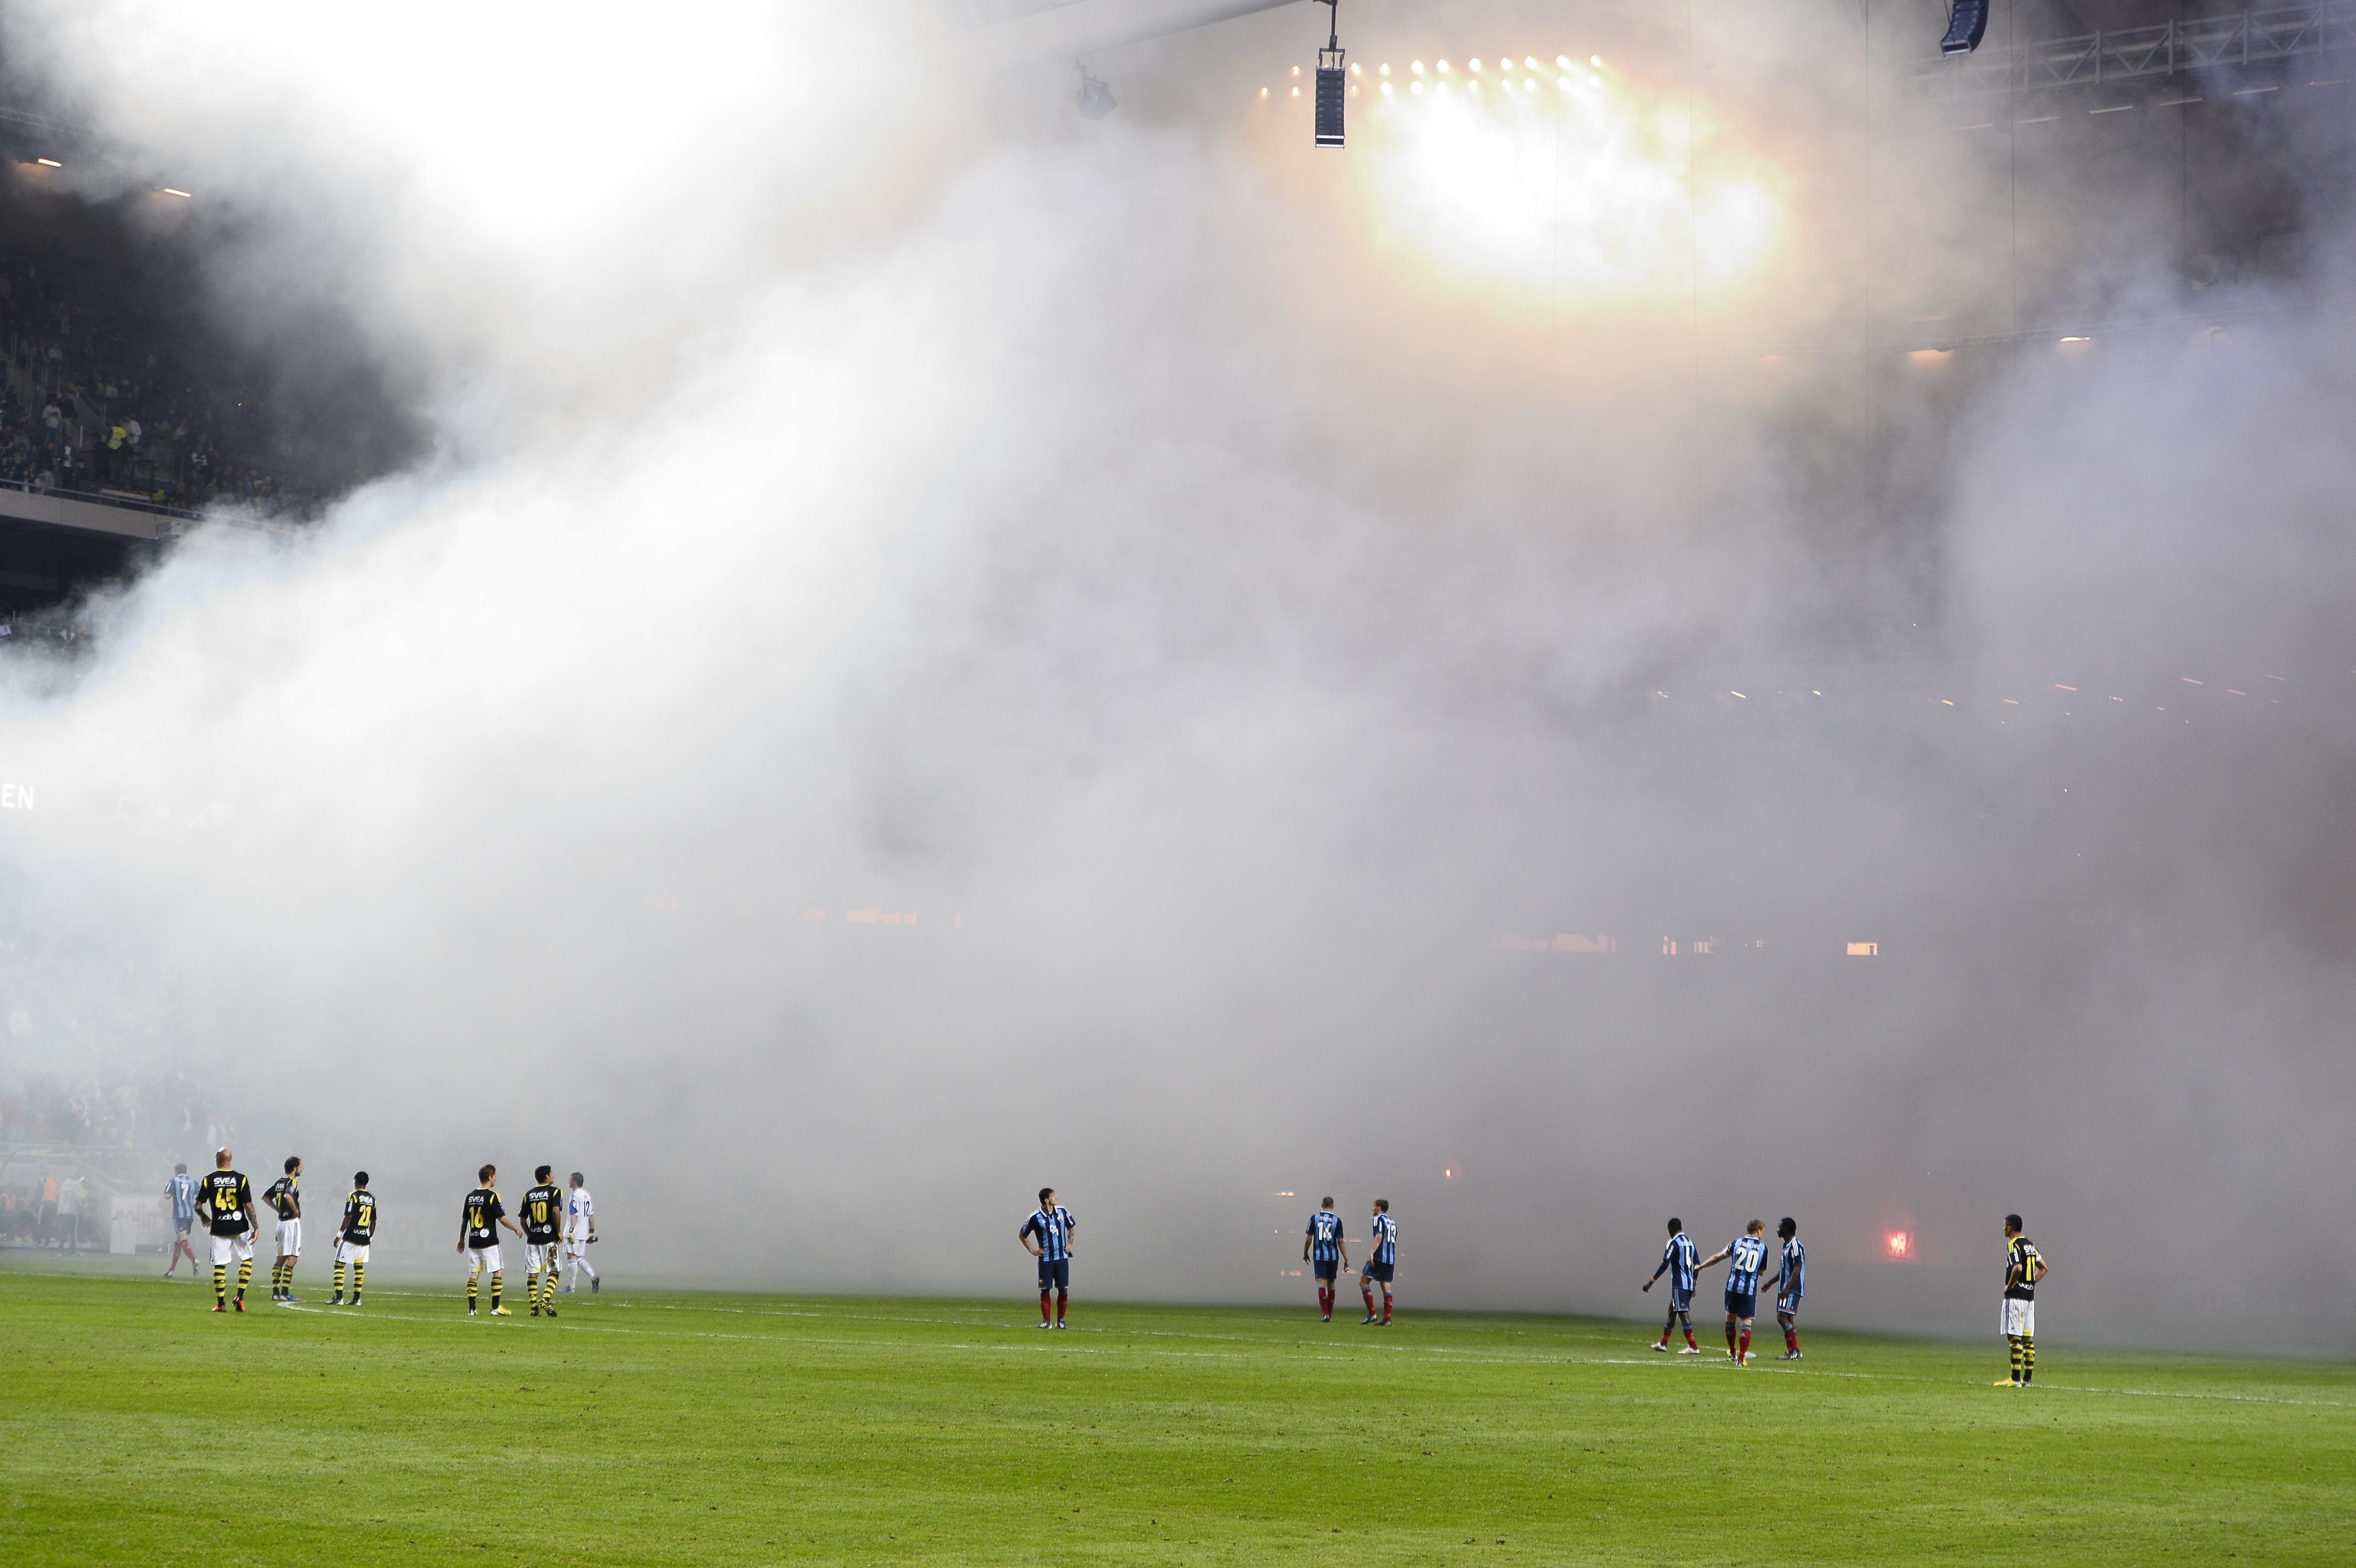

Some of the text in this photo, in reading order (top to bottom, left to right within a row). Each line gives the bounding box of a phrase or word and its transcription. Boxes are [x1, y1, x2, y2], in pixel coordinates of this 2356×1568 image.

[1, 783, 34, 810] EN
[181, 1184, 189, 1200] 7
[215, 1187, 237, 1210] 45
[276, 1192, 282, 1209] 7
[359, 1196, 372, 1204] SVEA
[529, 1191, 548, 1199] SVEA
[358, 1205, 371, 1227] 21
[469, 1206, 484, 1228] 16
[531, 1201, 547, 1223] 10
[583, 1200, 590, 1217] 12
[1318, 1222, 1332, 1241] 14
[1387, 1224, 1396, 1243] 13
[1734, 1247, 1759, 1272] 20
[2026, 1256, 2035, 1281] 11
